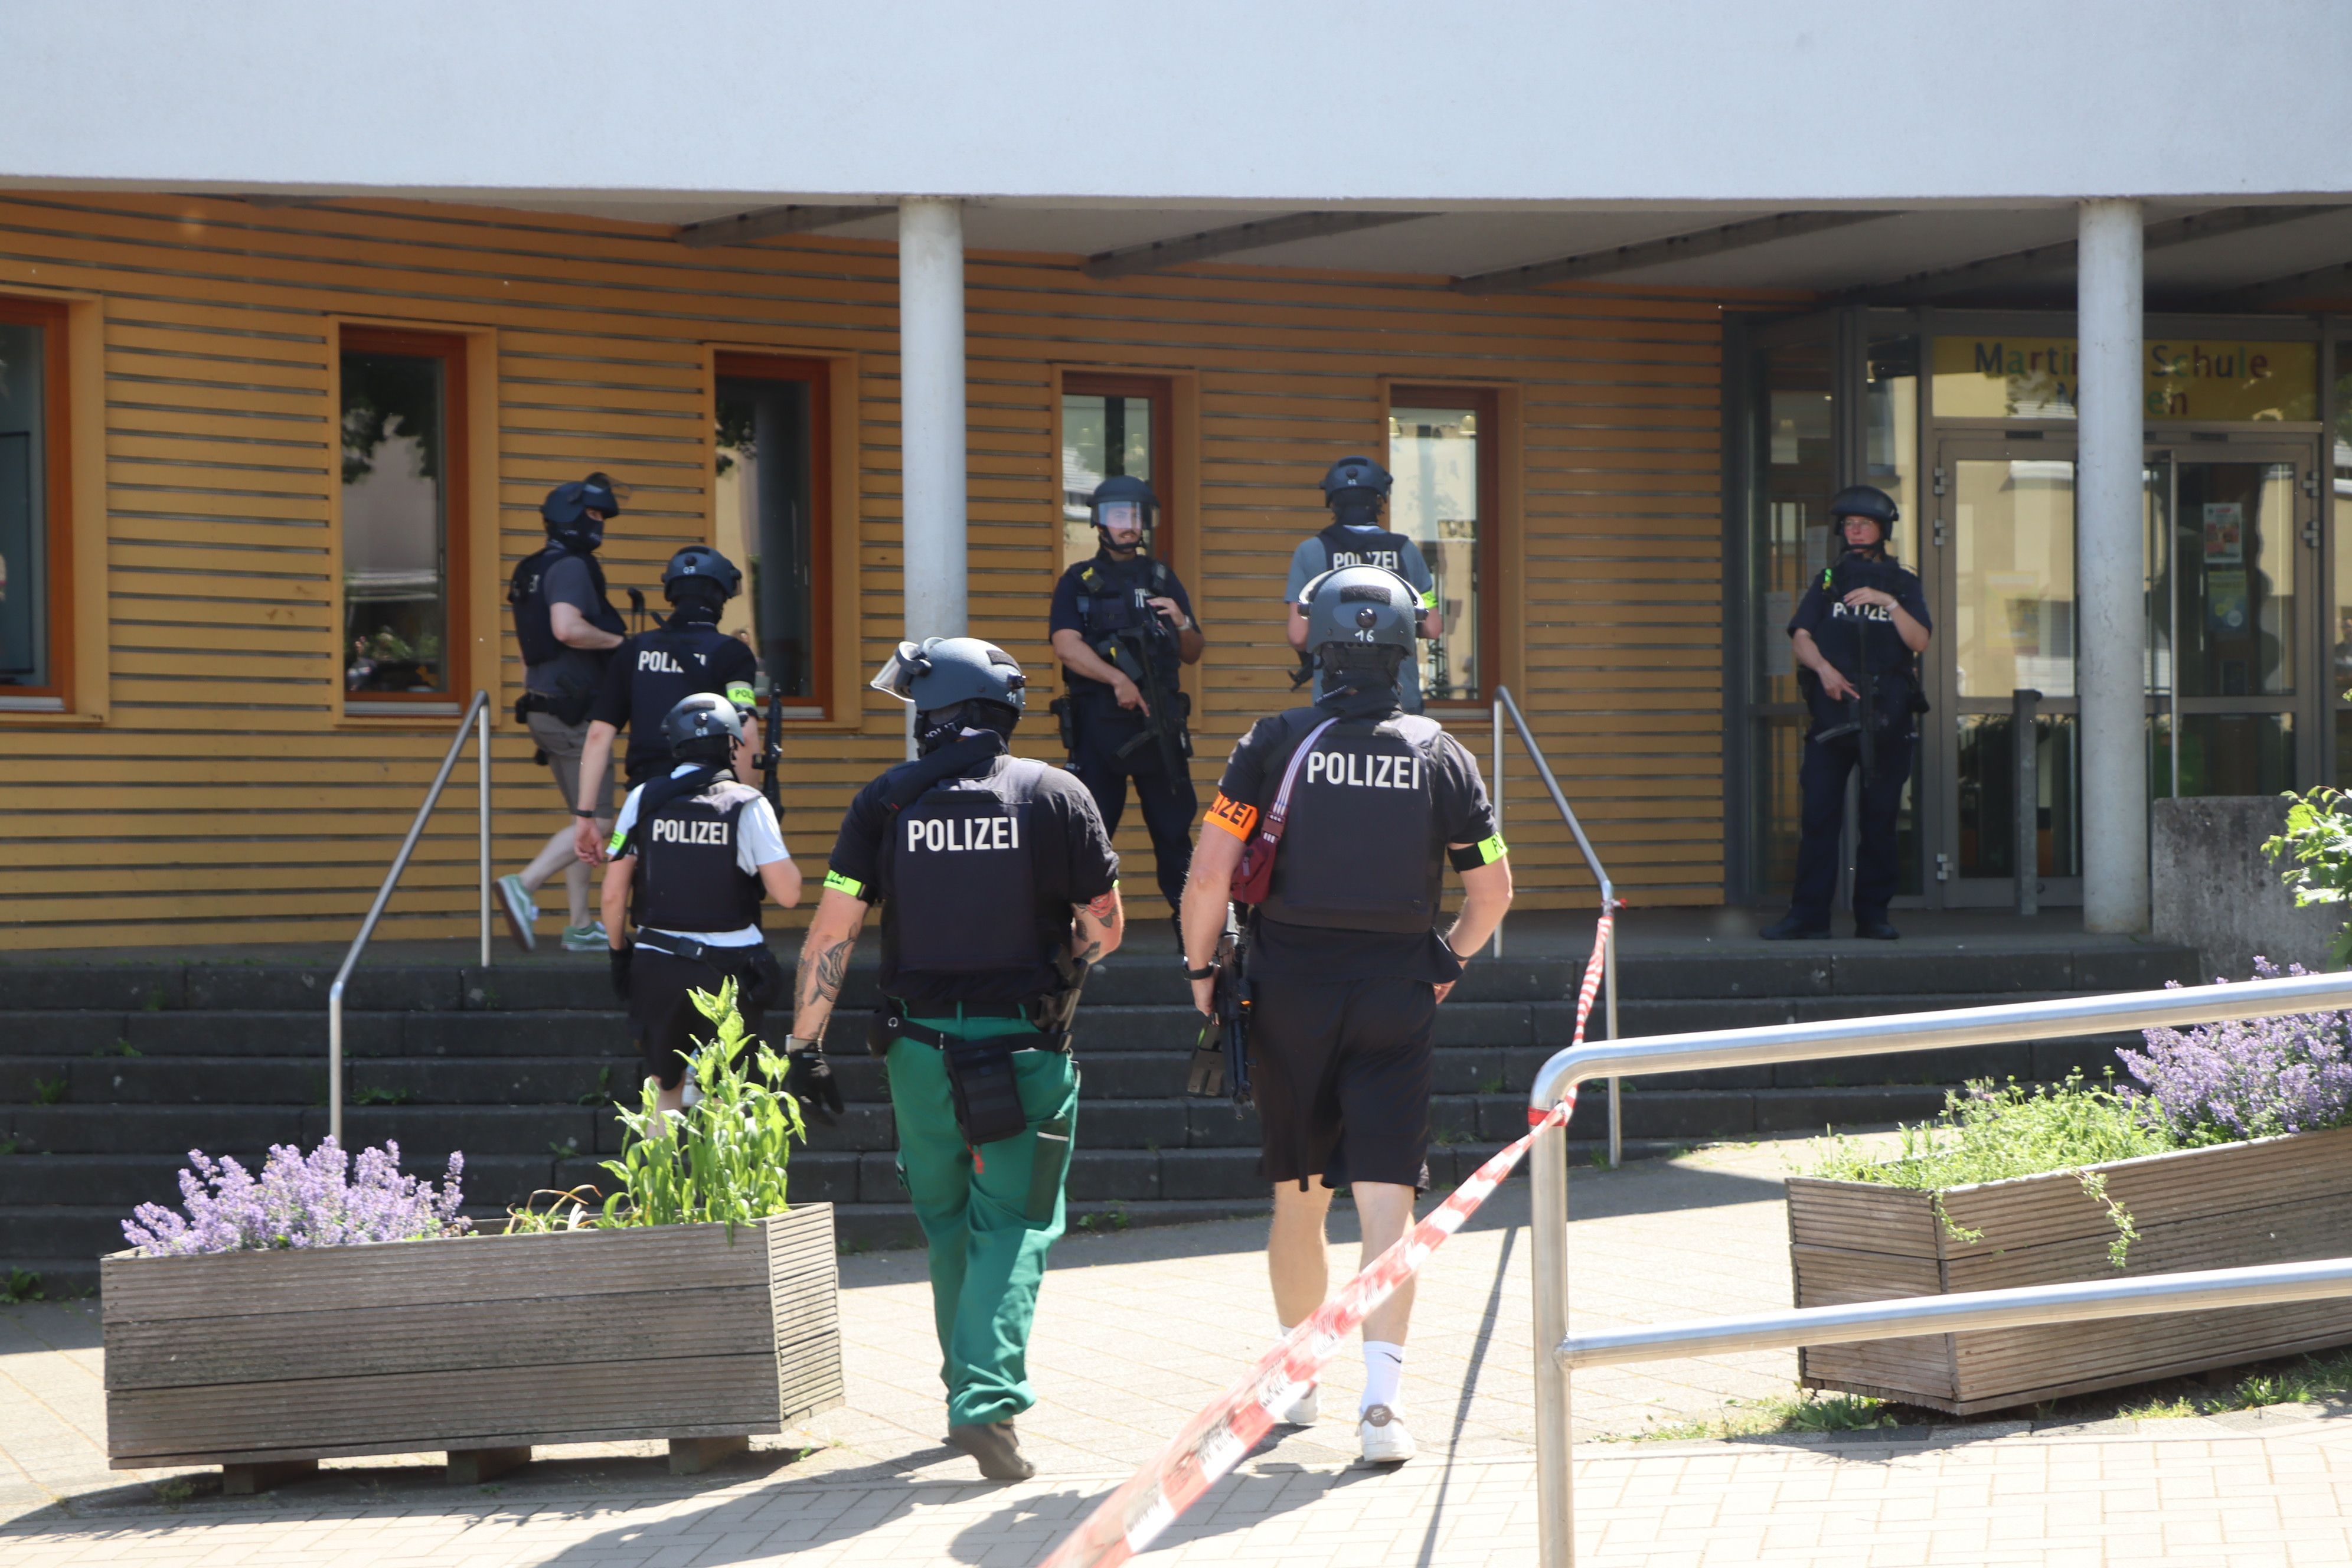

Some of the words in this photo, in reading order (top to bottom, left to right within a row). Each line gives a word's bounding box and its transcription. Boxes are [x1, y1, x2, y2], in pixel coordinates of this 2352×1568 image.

[2151, 344, 2268, 378] Schule
[1354, 629, 1374, 642] 16
[1307, 751, 1419, 790] POLIZEI
[652, 818, 729, 845] POLIZEI
[908, 816, 1019, 852] POLIZEI
